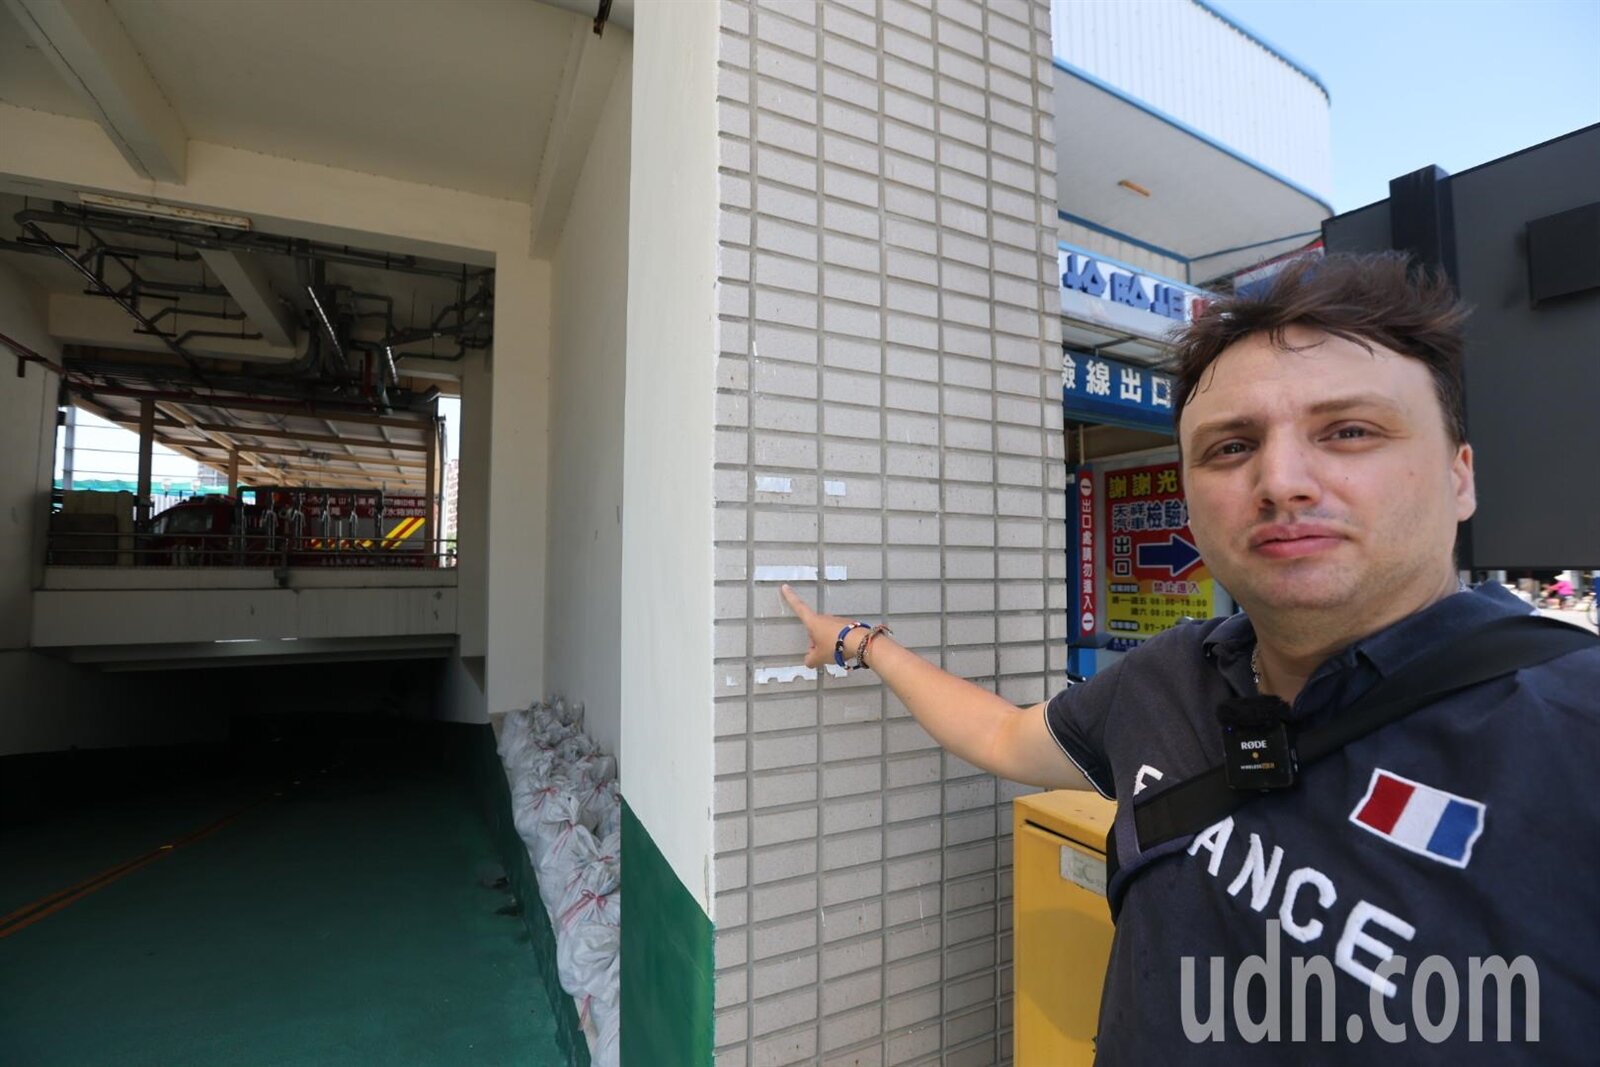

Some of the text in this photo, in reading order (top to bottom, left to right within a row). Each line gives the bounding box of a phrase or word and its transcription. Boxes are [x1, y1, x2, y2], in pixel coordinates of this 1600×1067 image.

[1147, 498, 1188, 530] 檢驗
[1113, 535, 1131, 578] 出口
[1153, 581, 1200, 595] 禁止進入
[1240, 739, 1268, 751] RØDE
[1133, 763, 1417, 999] FANCE
